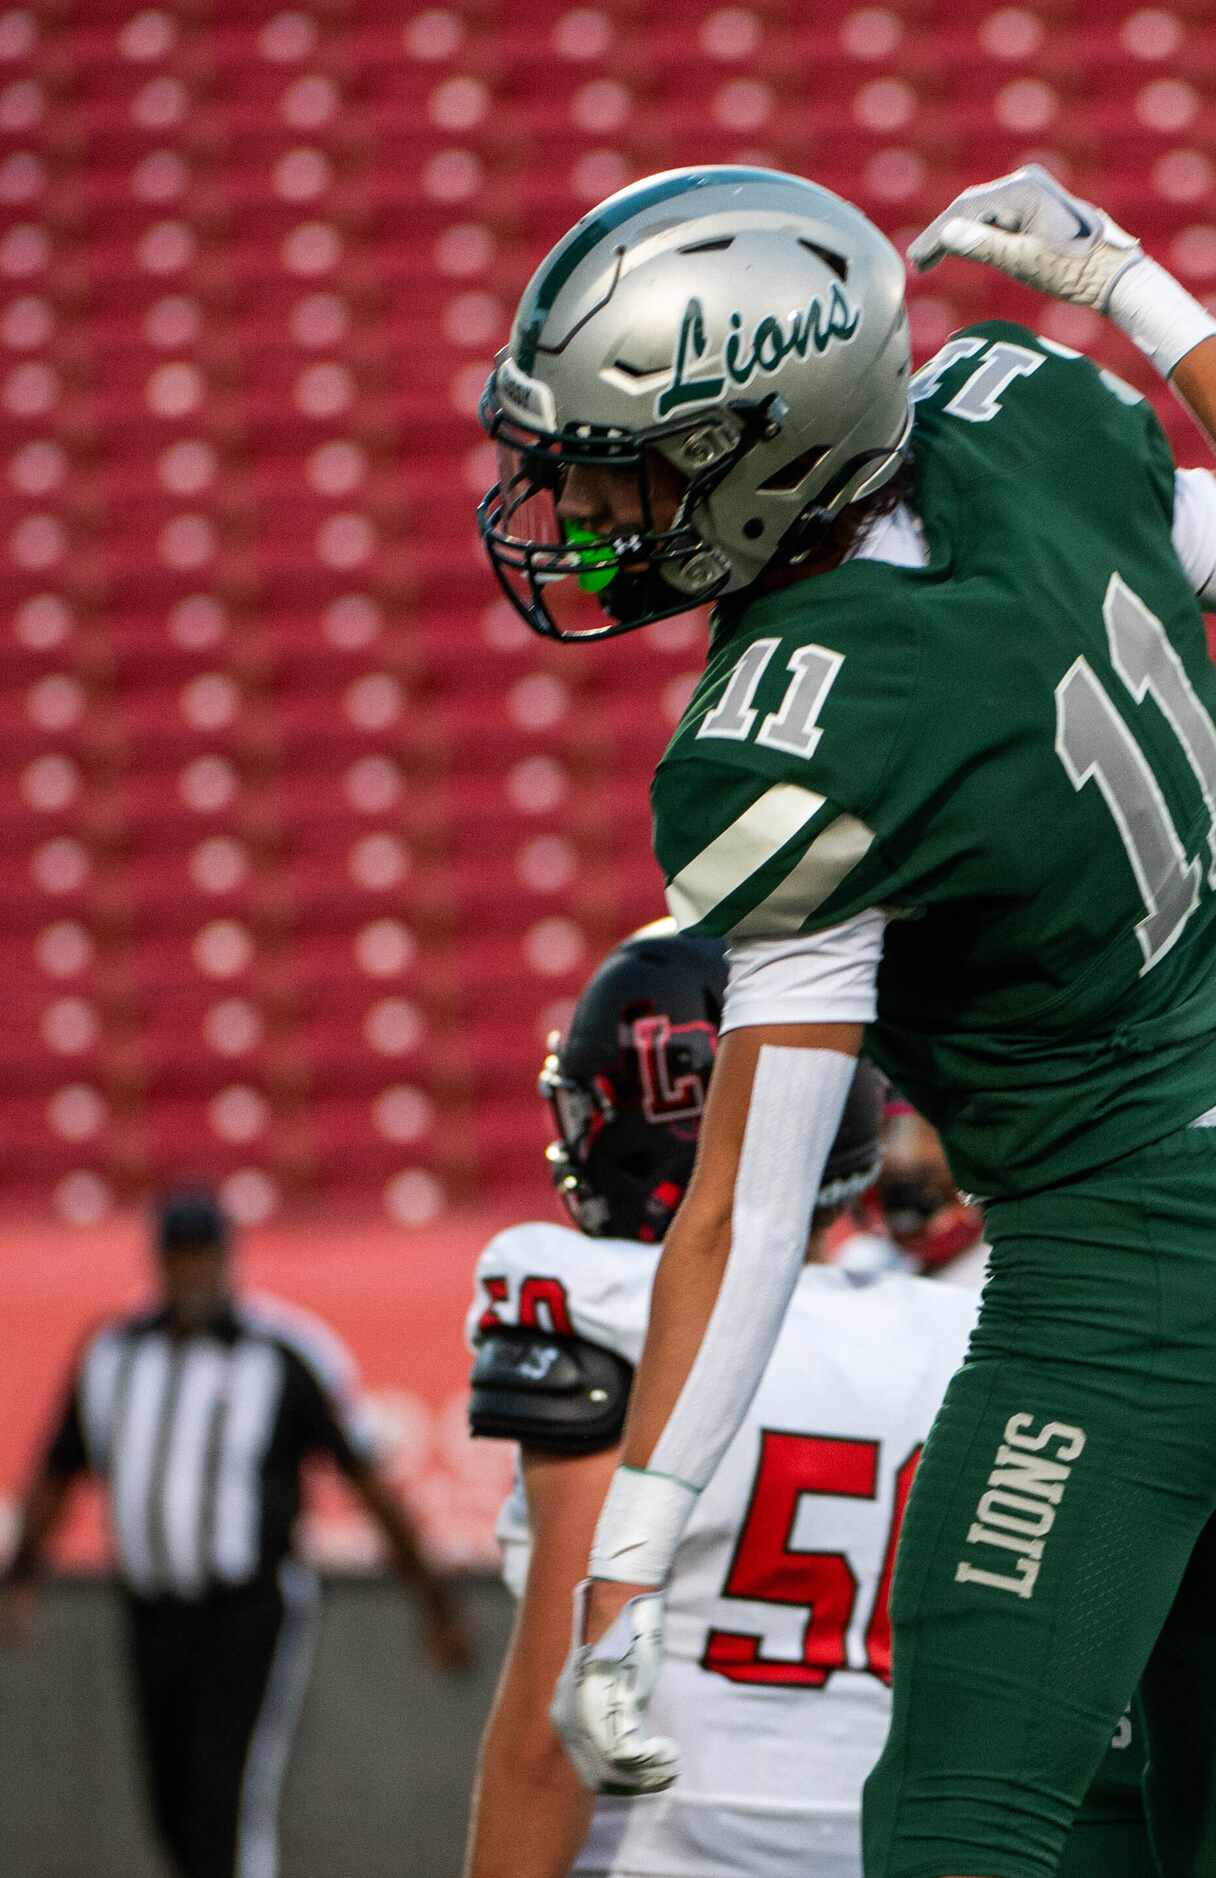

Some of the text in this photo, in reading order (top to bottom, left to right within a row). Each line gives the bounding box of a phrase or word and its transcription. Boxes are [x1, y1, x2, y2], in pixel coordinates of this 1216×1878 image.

[656, 282, 862, 419] Lions
[696, 638, 845, 760] 11
[955, 1412, 1086, 1599] LIONS
